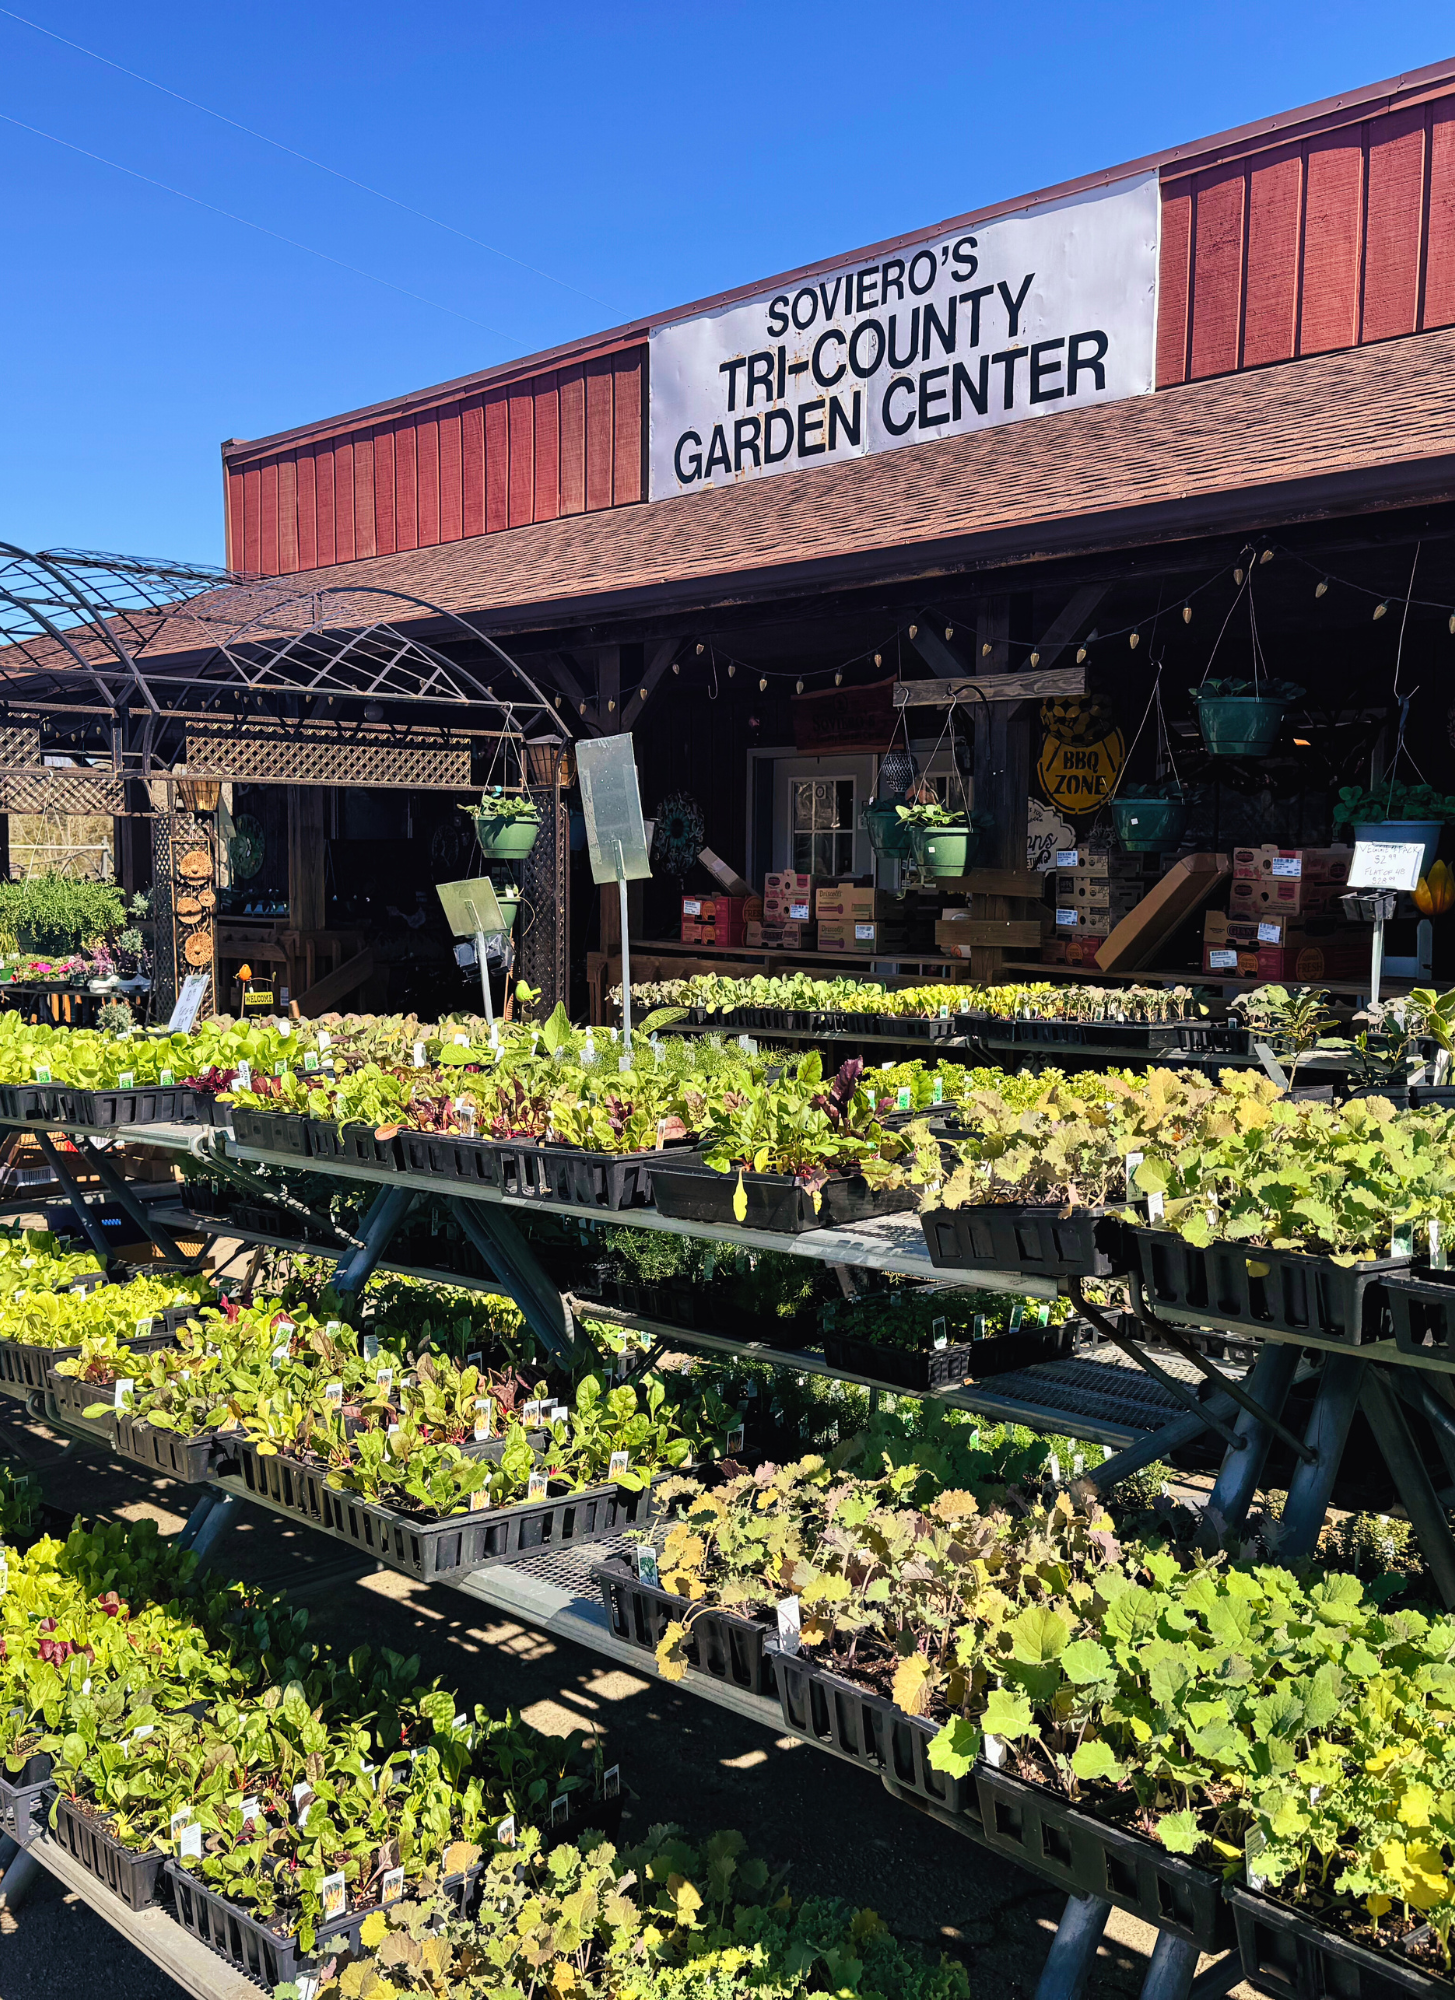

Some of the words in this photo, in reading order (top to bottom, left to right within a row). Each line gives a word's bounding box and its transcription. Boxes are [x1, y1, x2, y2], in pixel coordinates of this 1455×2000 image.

[767, 236, 979, 338] SOVIERO'S
[719, 272, 1036, 413] TRI-COUNTY
[674, 389, 862, 485] GARDEN
[882, 329, 1109, 436] CENTER
[1063, 751, 1099, 774] BBQ
[1053, 774, 1107, 796] ZONE
[1364, 866, 1383, 876] FLAT
[245, 994, 272, 1004] WELCOME
